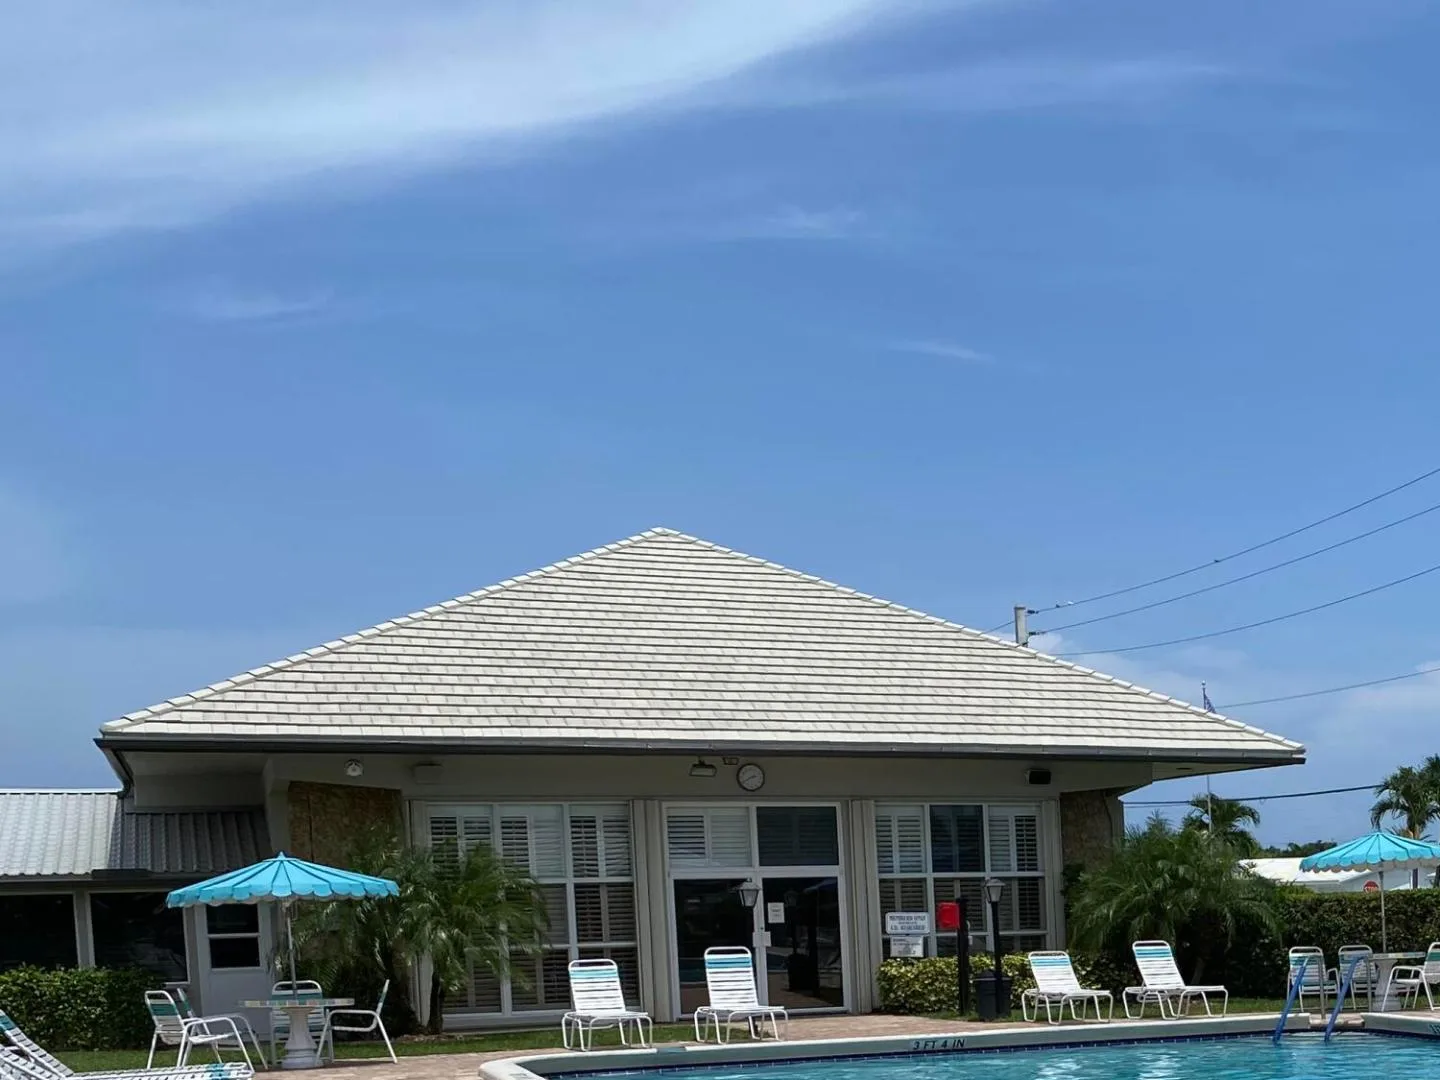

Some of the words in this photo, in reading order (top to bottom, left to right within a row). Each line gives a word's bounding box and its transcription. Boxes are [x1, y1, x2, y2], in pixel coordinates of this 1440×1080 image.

[913, 1040, 920, 1050] 3
[923, 1040, 937, 1049] FT
[940, 1039, 948, 1049] 4
[952, 1038, 965, 1048] IN
